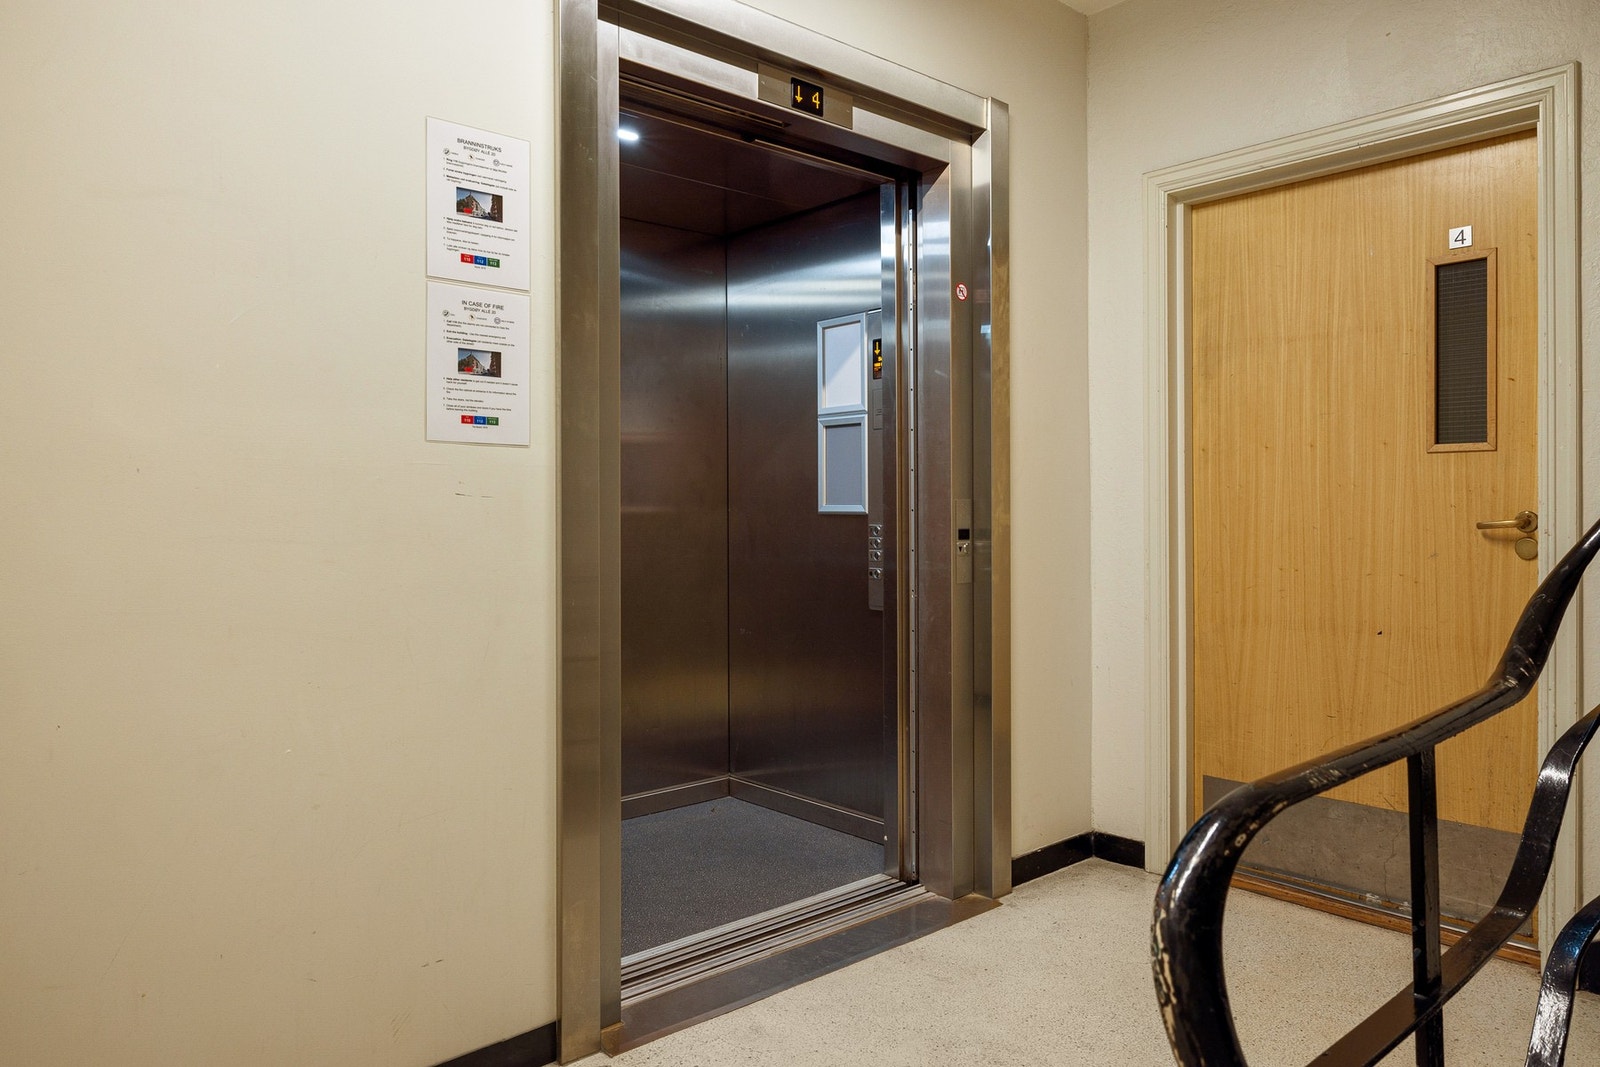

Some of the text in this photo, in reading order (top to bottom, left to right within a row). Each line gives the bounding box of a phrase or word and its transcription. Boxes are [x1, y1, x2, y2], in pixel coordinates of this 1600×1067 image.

[811, 91, 820, 109] 4
[457, 138, 502, 152] BRANNINSTRUKS
[1454, 229, 1467, 245] 4
[468, 300, 483, 308] CASE
